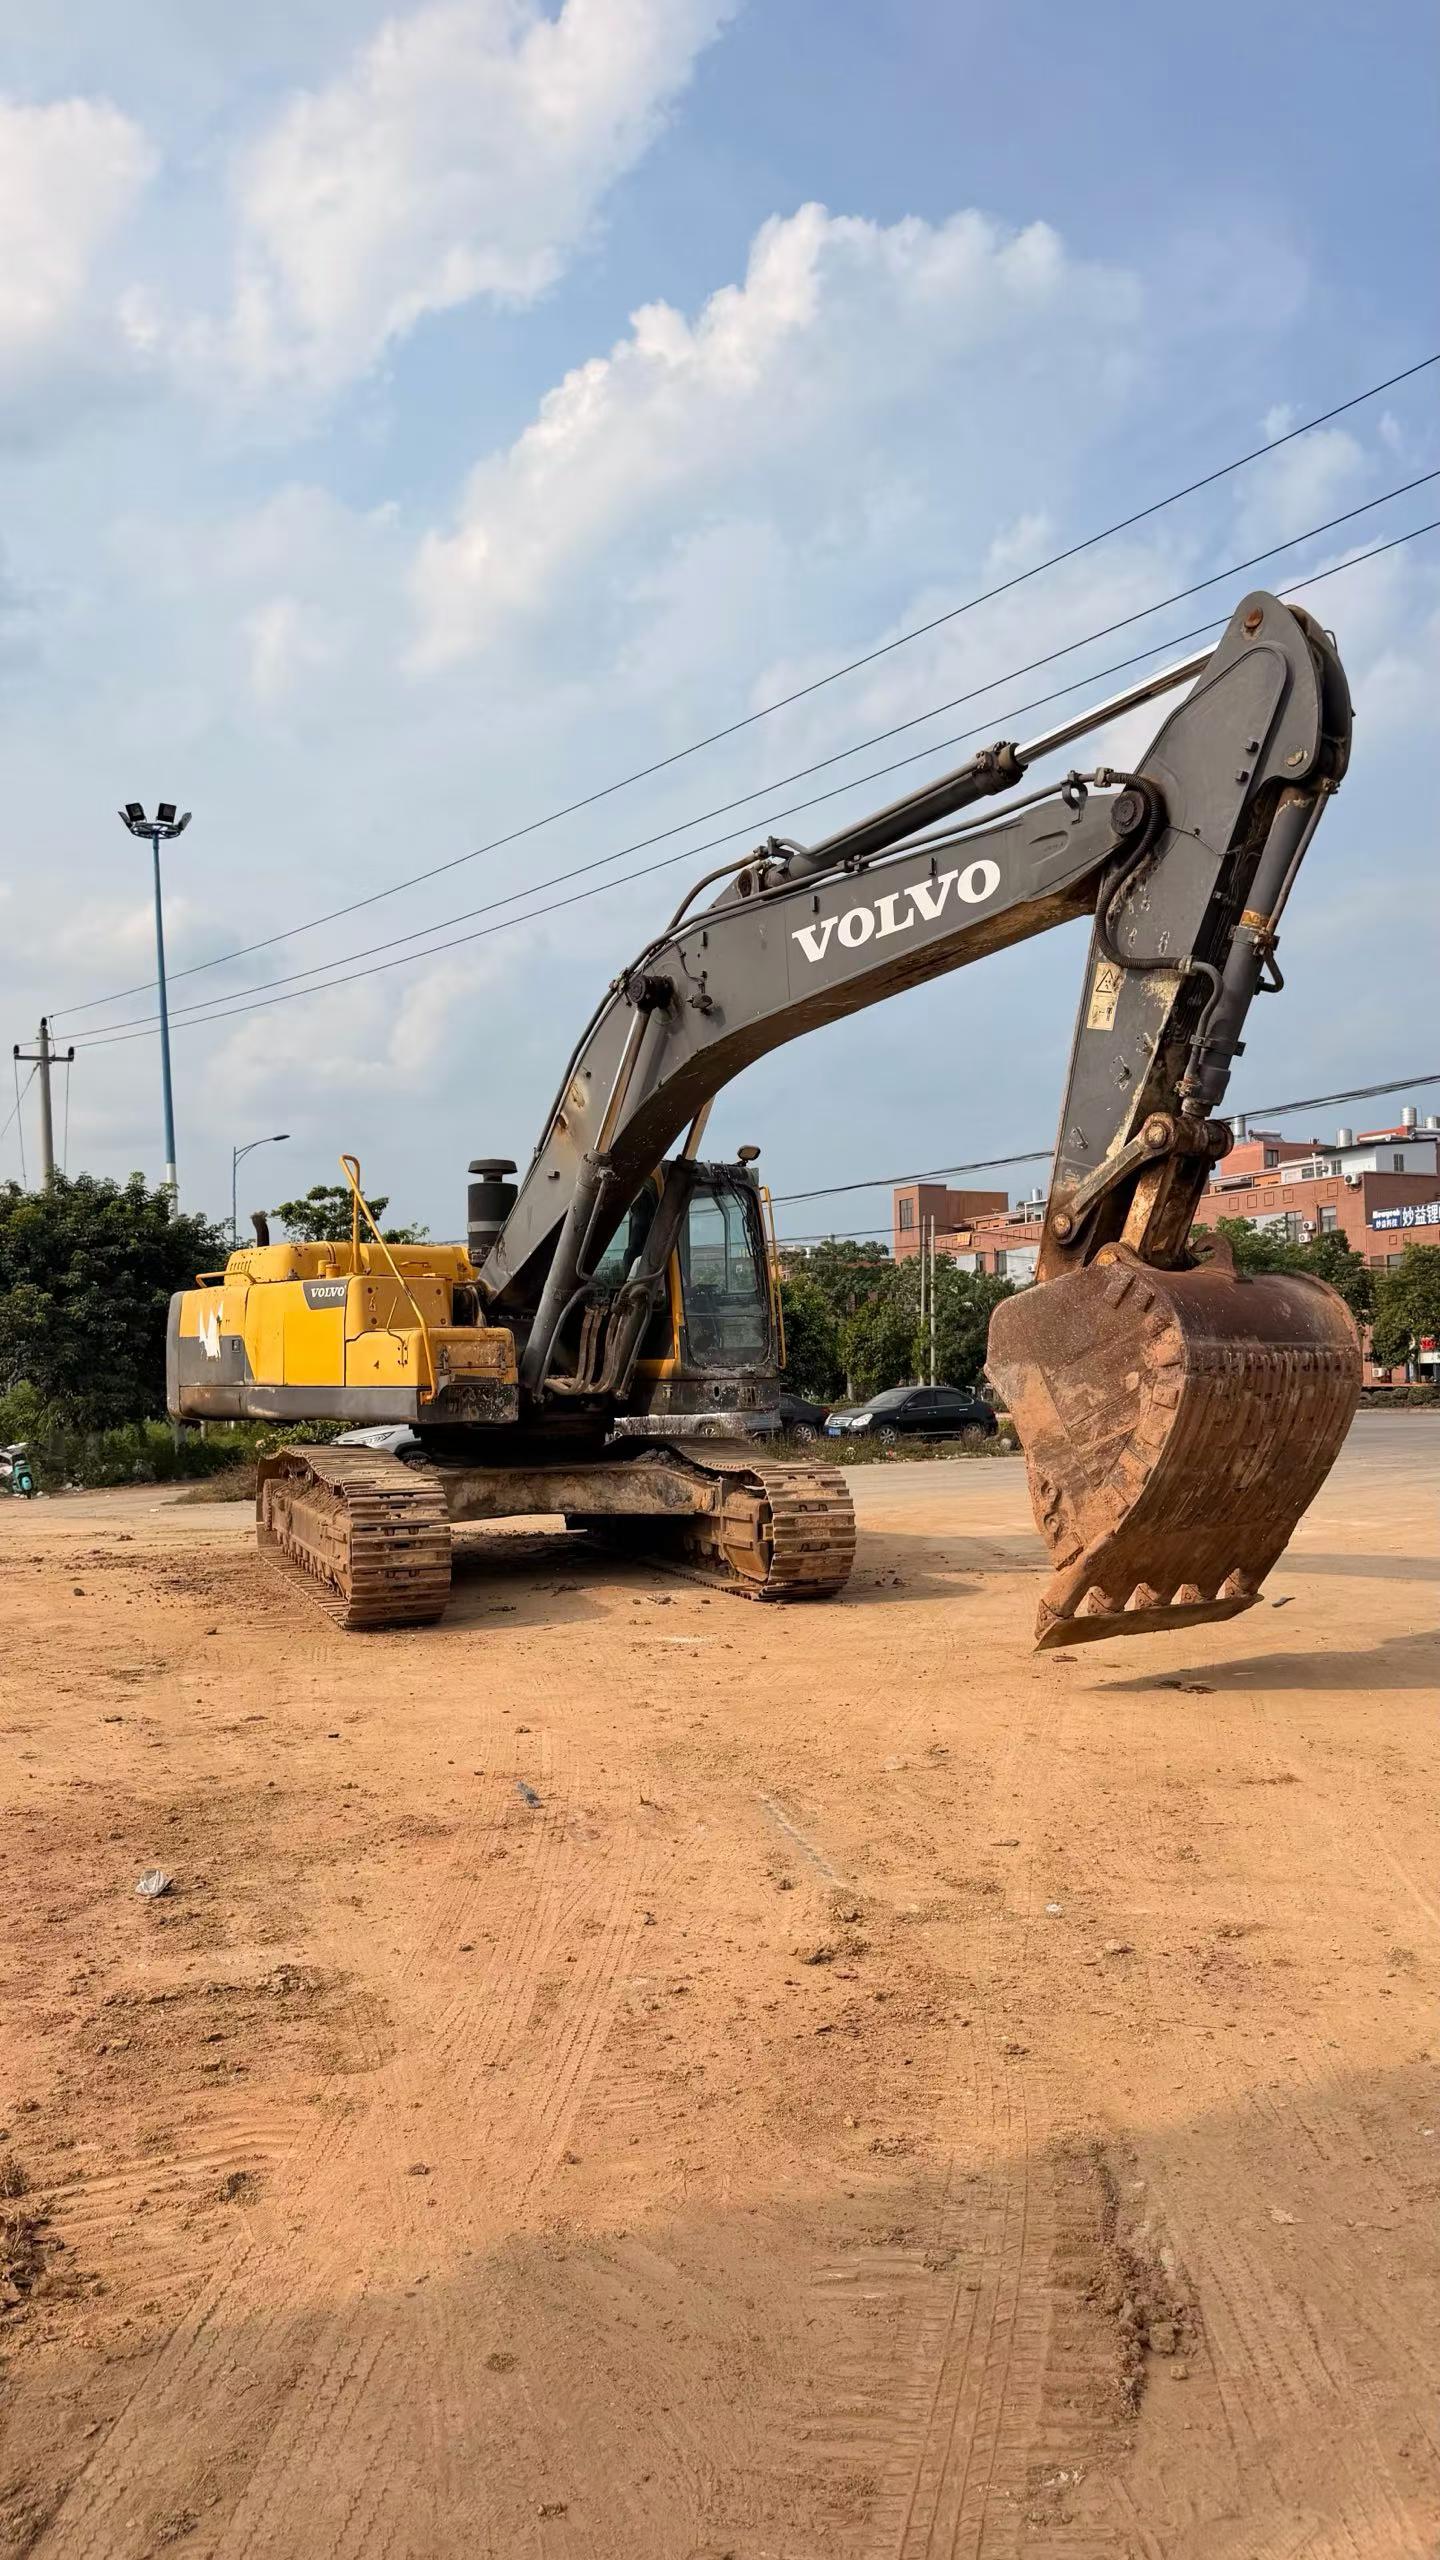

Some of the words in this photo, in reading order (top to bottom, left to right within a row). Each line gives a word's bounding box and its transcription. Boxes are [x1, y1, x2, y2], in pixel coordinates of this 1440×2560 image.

[792, 859, 1001, 963] VOLVO
[1402, 1204, 1440, 1227] 妙益锂
[311, 1286, 345, 1298] VOLVO
